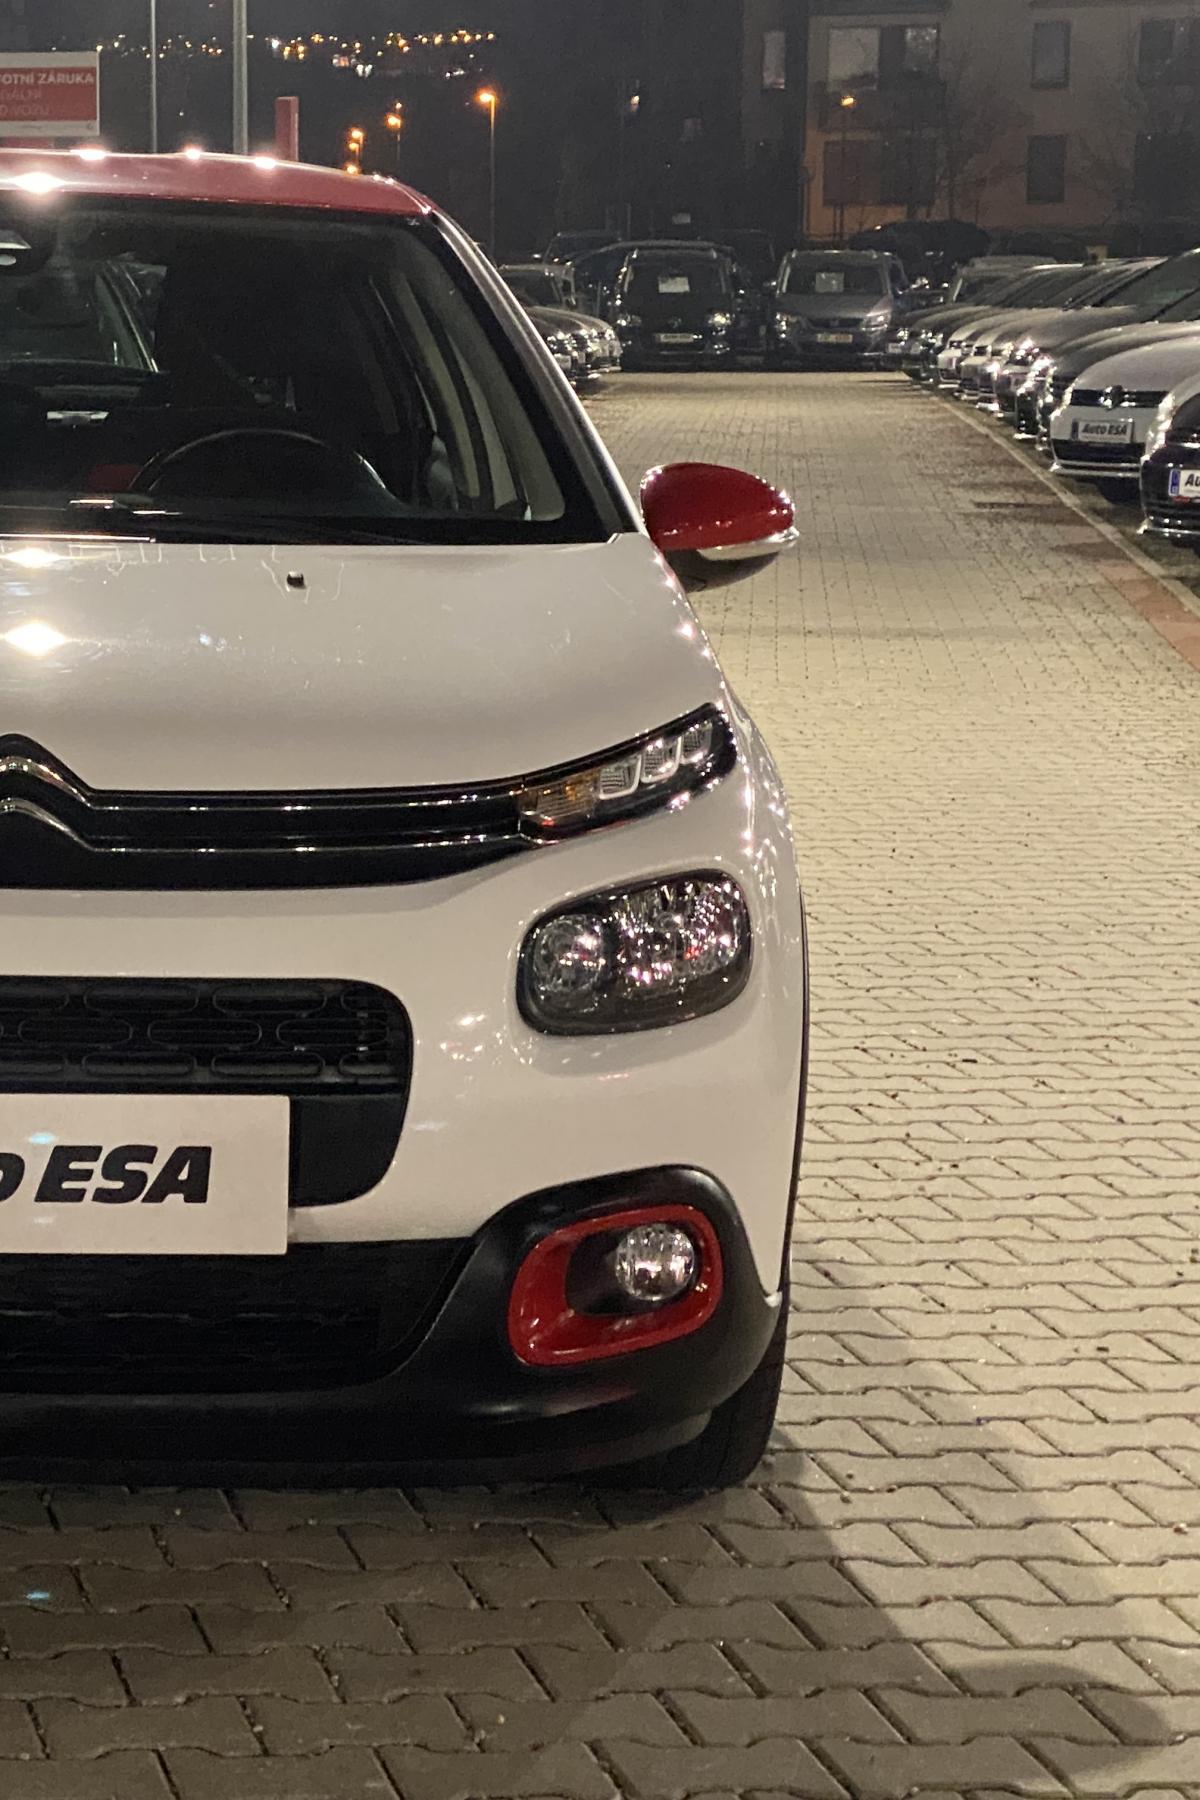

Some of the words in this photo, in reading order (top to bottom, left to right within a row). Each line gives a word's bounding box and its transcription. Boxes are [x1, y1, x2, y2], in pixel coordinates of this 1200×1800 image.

[38, 72, 94, 84] ZÁRUKA
[1082, 423, 1107, 435] Auto
[34, 1144, 213, 1204] ESA
